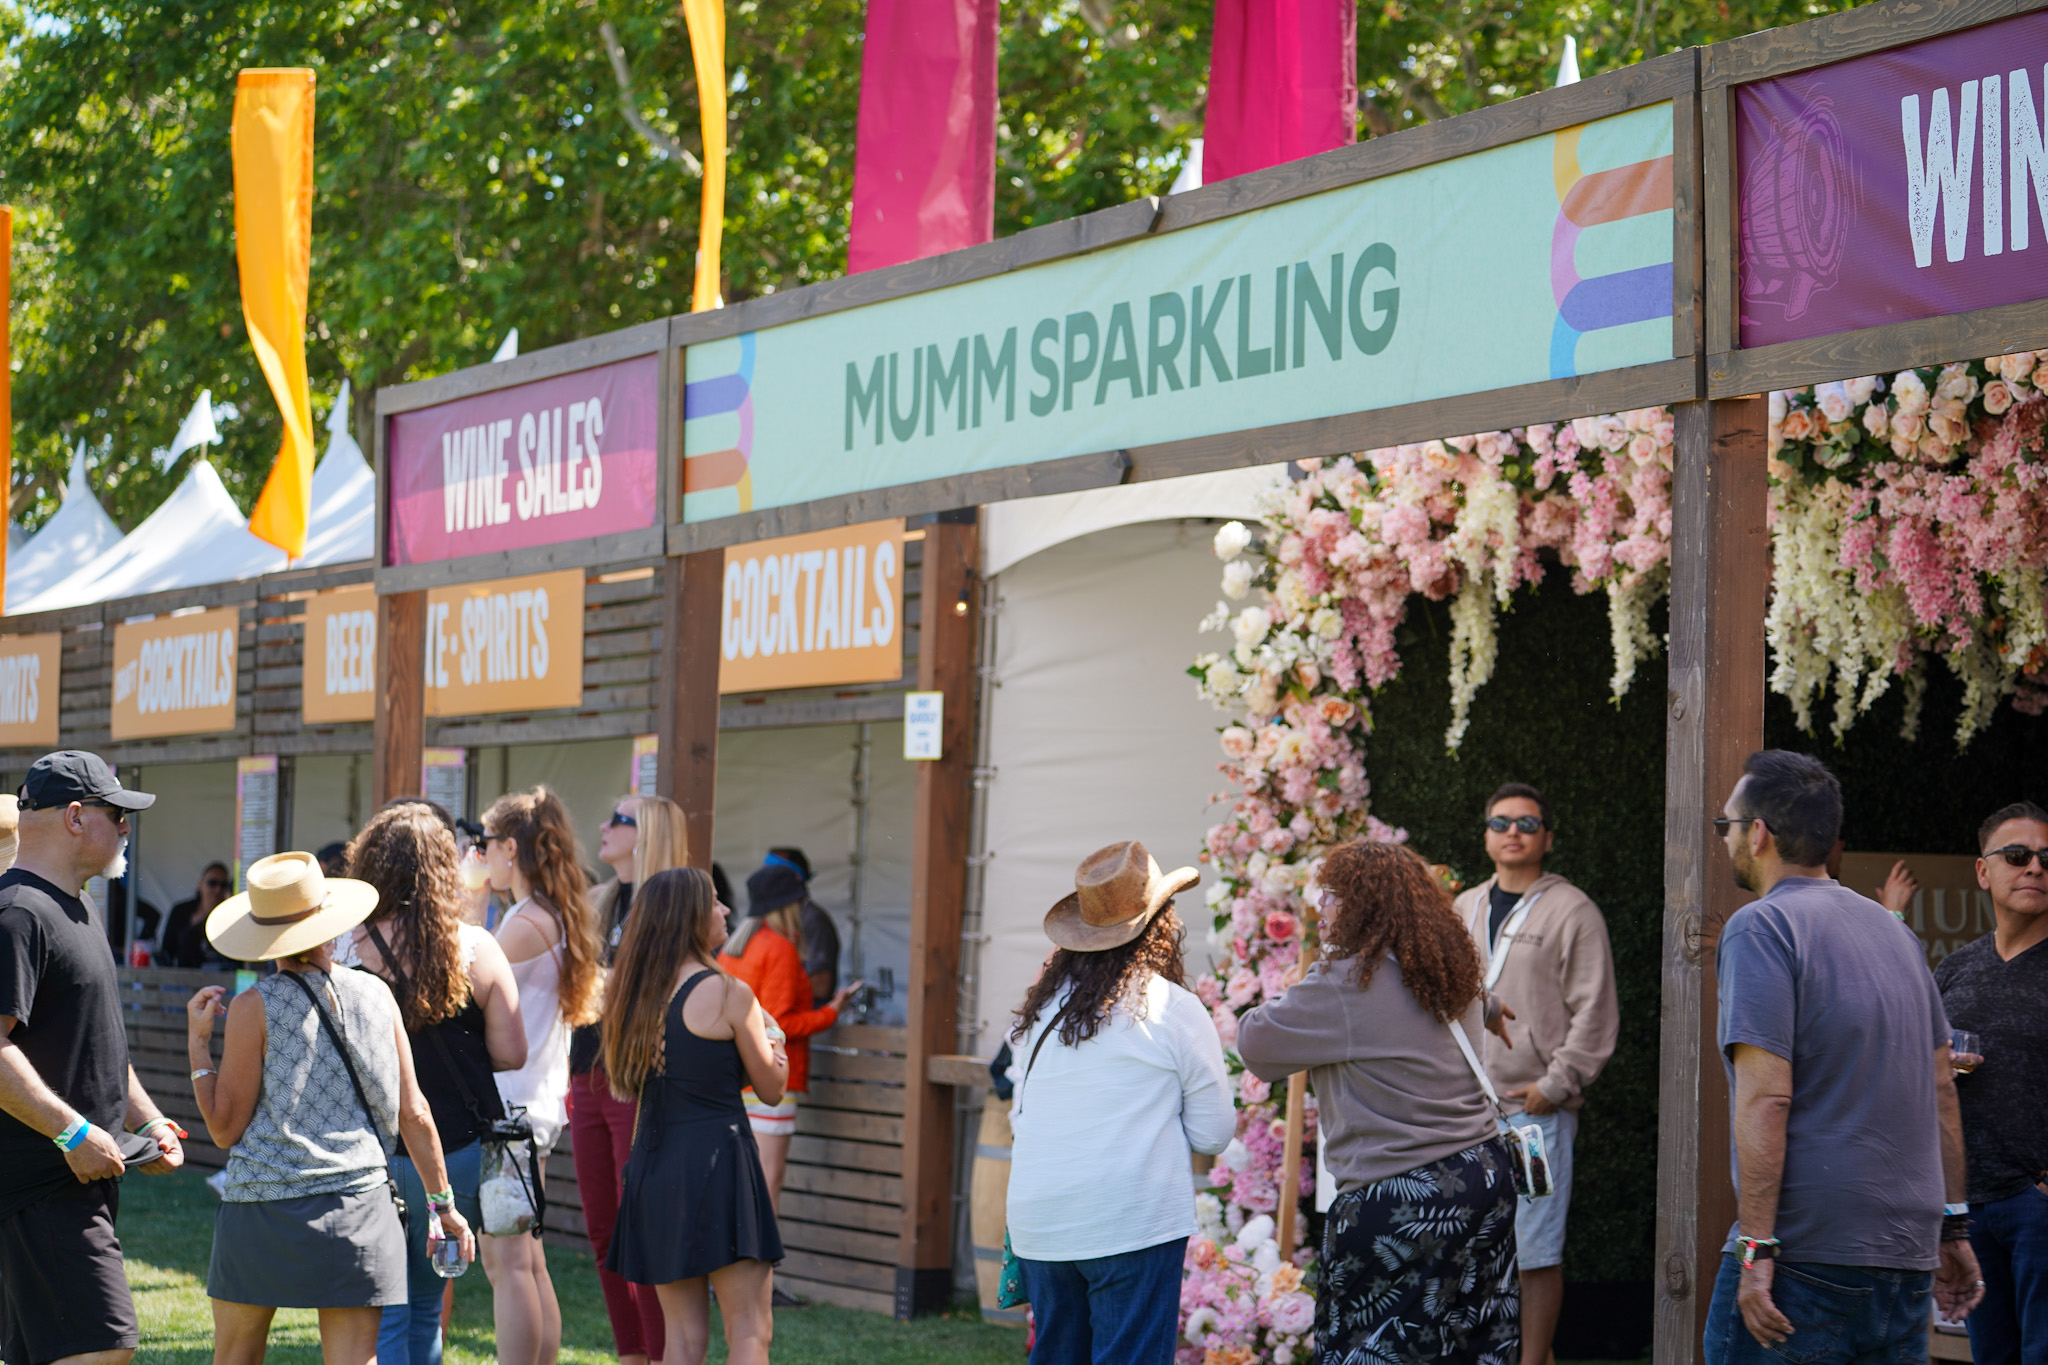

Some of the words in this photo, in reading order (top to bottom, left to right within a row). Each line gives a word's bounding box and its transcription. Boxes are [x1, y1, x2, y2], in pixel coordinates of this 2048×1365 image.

[844, 327, 1017, 451] MUMM
[1029, 242, 1400, 417] SPARKLING
[442, 418, 513, 533] WINE
[516, 396, 603, 521] SALES
[325, 609, 376, 695] BEER
[722, 540, 896, 661] COCKTAILS
[138, 627, 234, 715] COCKTAILS
